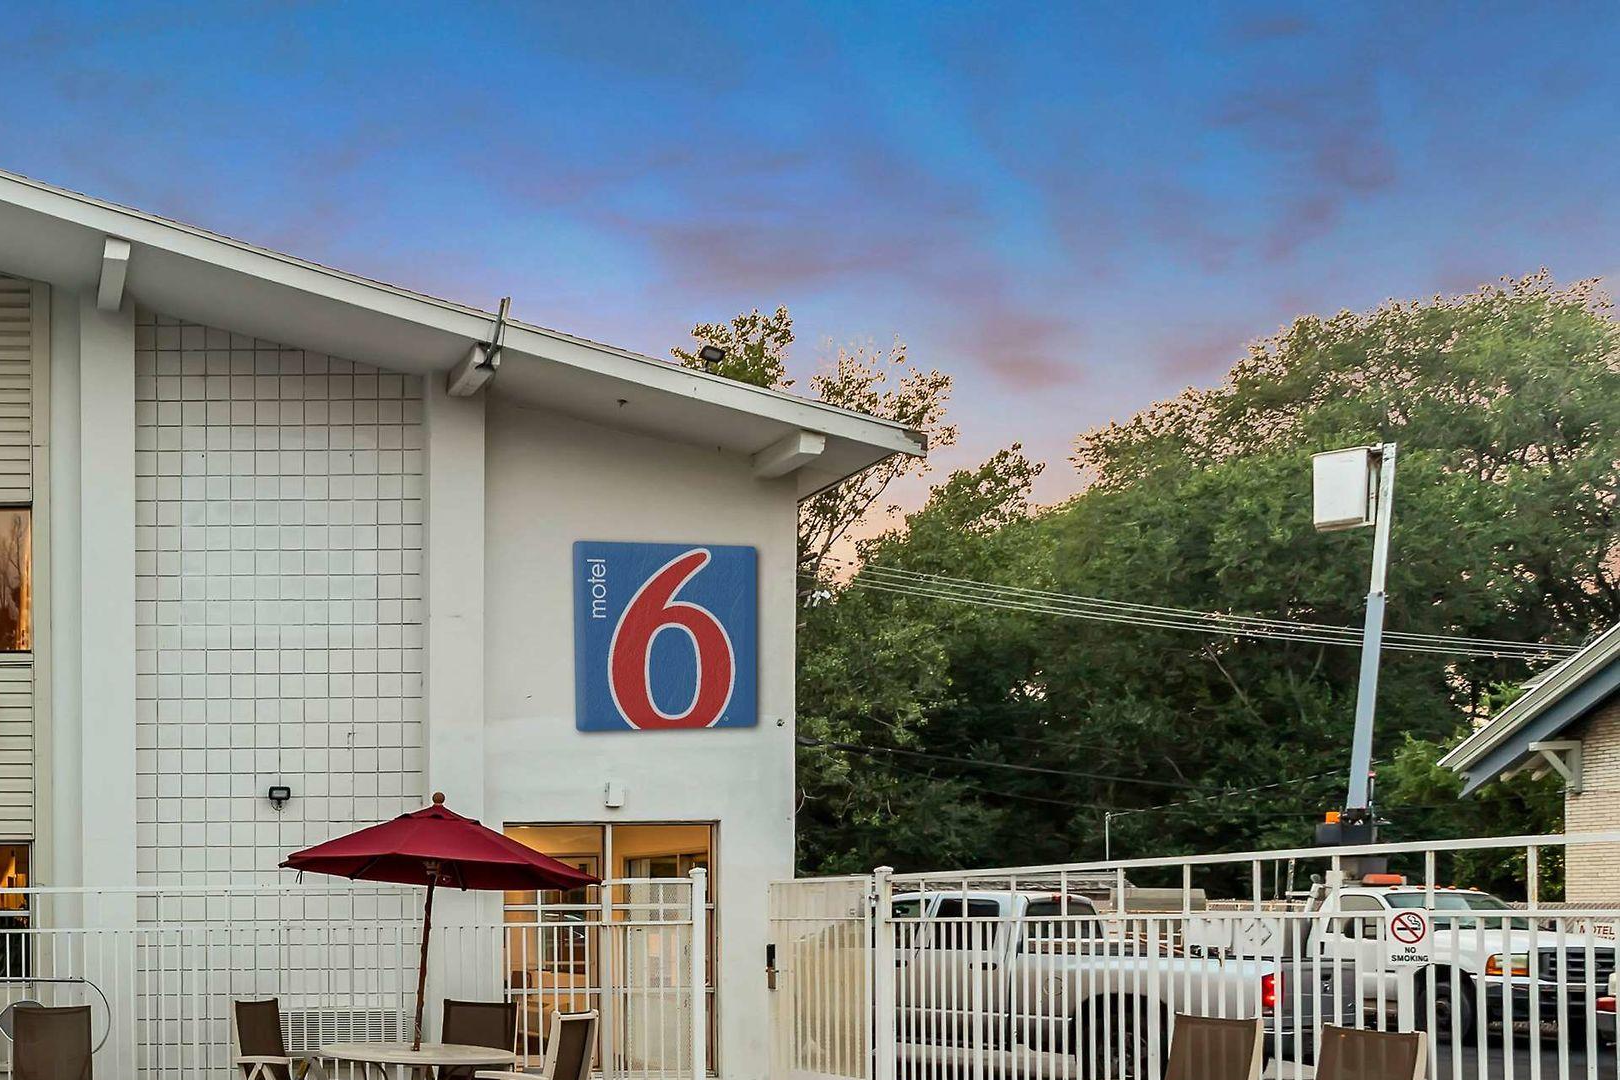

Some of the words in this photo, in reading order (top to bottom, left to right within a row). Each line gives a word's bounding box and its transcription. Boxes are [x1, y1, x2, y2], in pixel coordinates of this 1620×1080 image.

[587, 558, 607, 619] motel
[607, 547, 736, 730] 6
[1391, 954, 1429, 962] SMOKING
[1404, 946, 1417, 954] NO
